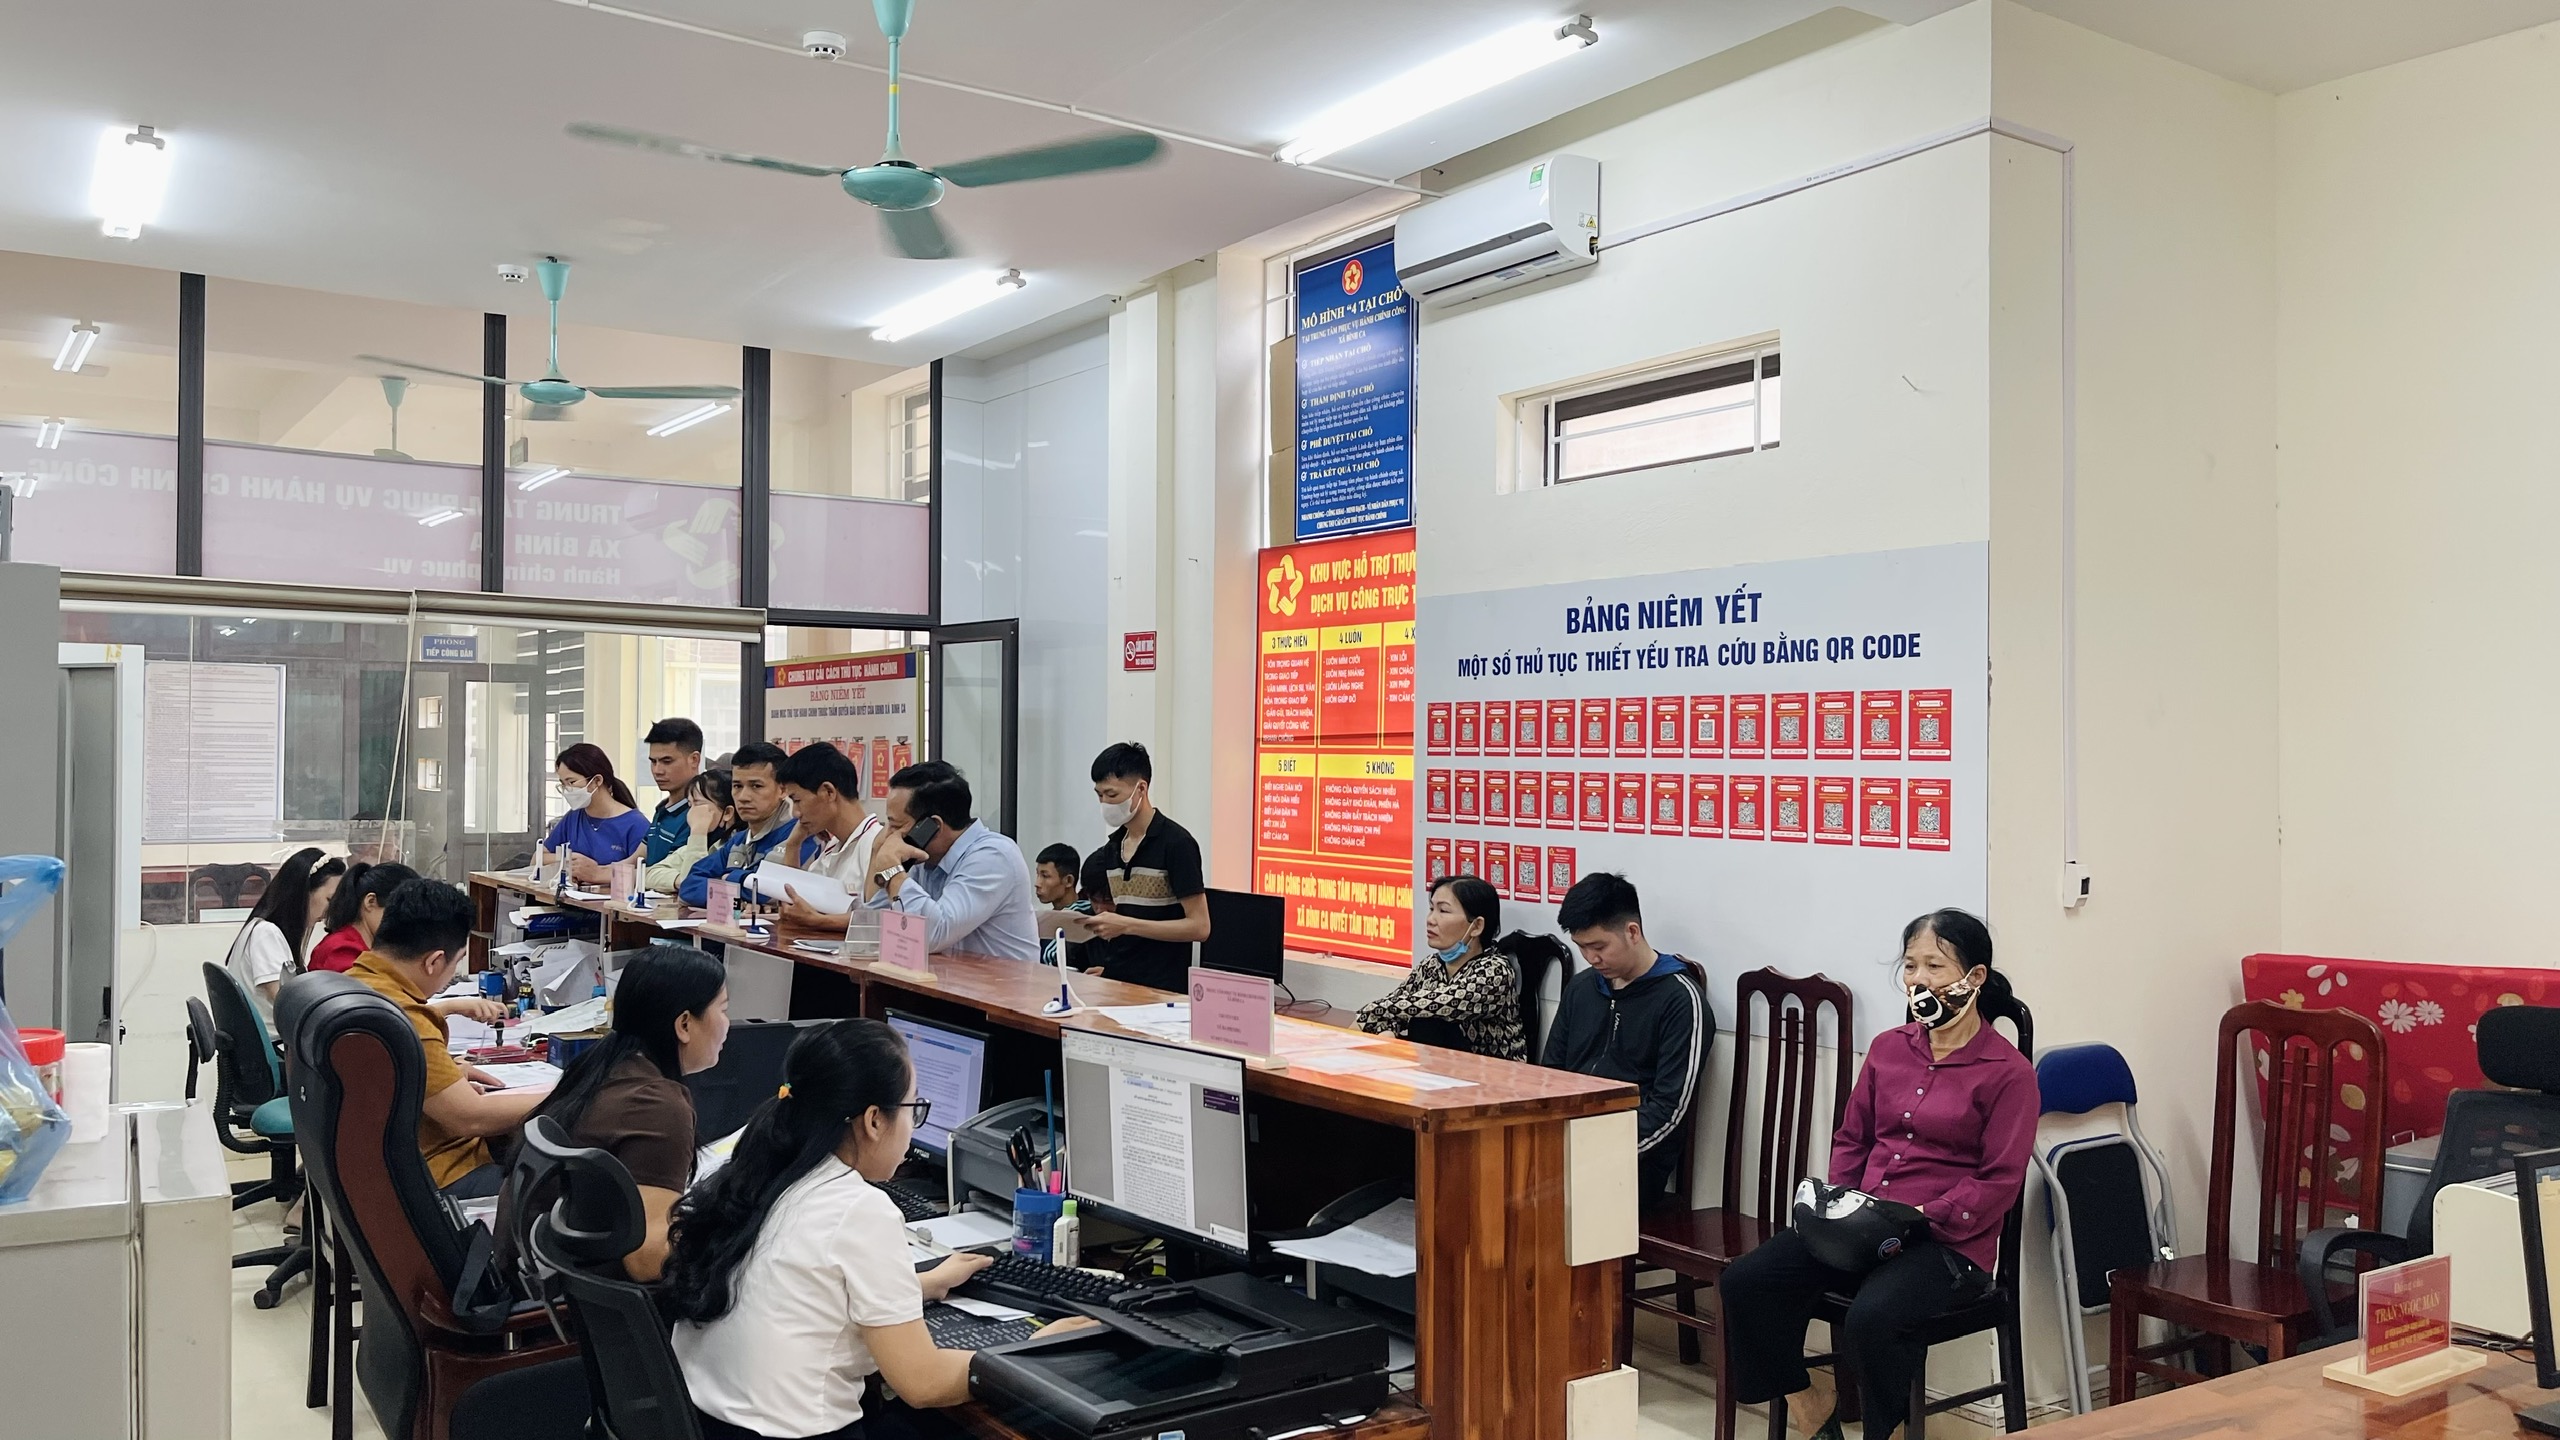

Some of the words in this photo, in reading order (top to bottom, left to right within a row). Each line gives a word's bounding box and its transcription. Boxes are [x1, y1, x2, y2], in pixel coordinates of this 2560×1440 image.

[1302, 312, 1317, 330] MÔ
[1320, 306, 1344, 324] HÌNH
[1347, 302, 1357, 314] “4
[1359, 296, 1376, 313] TẠI
[1310, 562, 1330, 584] KHU
[1332, 558, 1351, 584] VỰC
[1354, 550, 1368, 578] HỖ
[1370, 553, 1391, 580] TRỢ
[1311, 593, 1333, 617] DỊCH
[1336, 591, 1349, 615] VỤ
[1351, 586, 1379, 610] CÔNG
[1382, 583, 1409, 610] TRỰC
[1566, 596, 1630, 634] BẢNG
[1638, 594, 1702, 630] NIÊM
[1715, 583, 1762, 624] YẾT
[426, 646, 439, 656] TIẾP
[441, 647, 458, 657] CÔNG
[460, 648, 473, 657] DÂN
[1458, 654, 1488, 680] MỘT
[1492, 649, 1511, 676] SỐ
[1516, 647, 1543, 675] THỦ
[1548, 652, 1578, 676] TỤC
[1586, 642, 1631, 672] THIẾT
[1636, 640, 1669, 670] YẾU
[1675, 644, 1709, 668] TRA
[1718, 637, 1756, 666] CỨU
[1763, 632, 1819, 664] BẰNG
[1826, 636, 1854, 663] QR
[1862, 633, 1920, 660] CODE
[810, 686, 829, 701] BẢNG
[831, 686, 849, 700] NIÊM
[852, 684, 866, 699] YẾT
[1366, 761, 1370, 774] 5
[1372, 759, 1394, 774] KHÔNG
